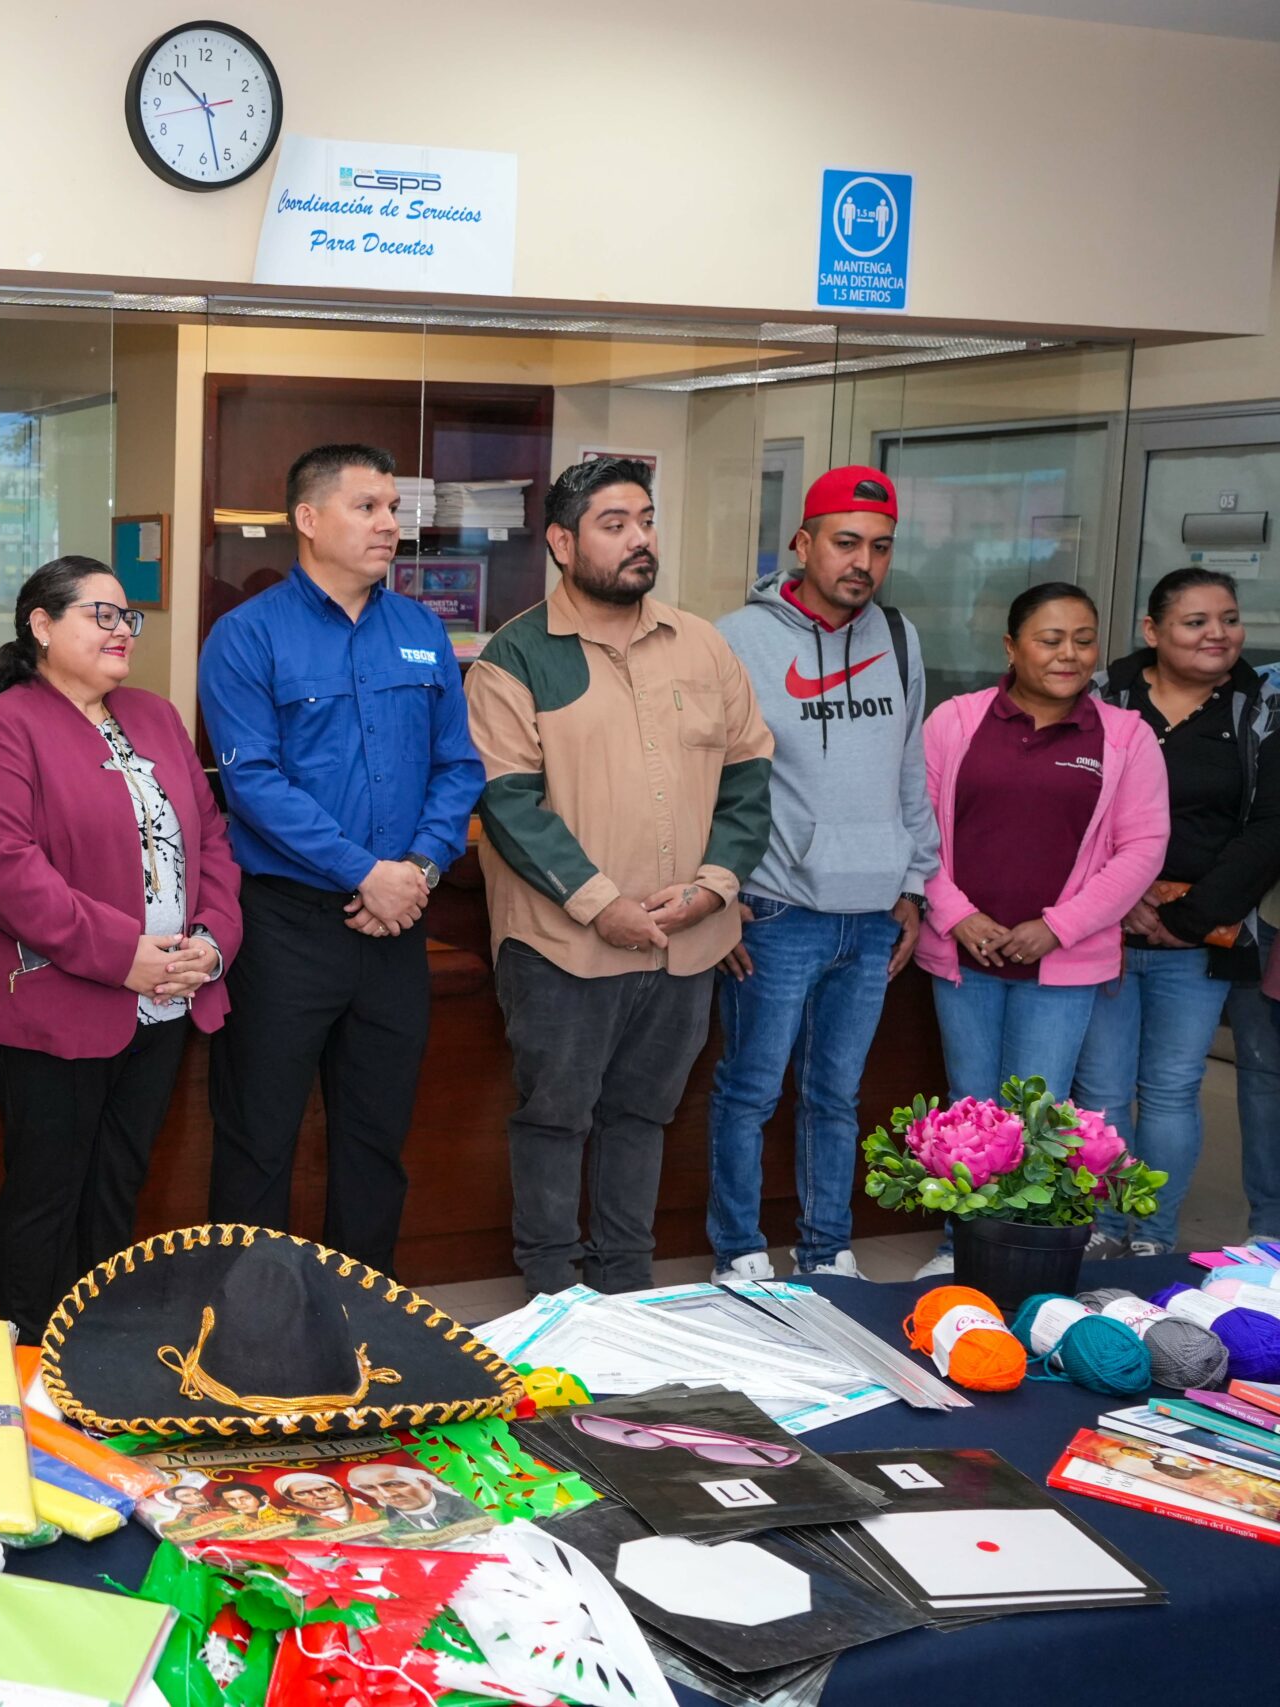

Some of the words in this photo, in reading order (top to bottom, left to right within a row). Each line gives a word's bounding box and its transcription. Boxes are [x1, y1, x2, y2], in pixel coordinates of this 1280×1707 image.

[175, 54, 187, 68] 11
[198, 48, 212, 62] 12
[226, 58, 231, 71] 1
[157, 72, 172, 86] 10
[241, 79, 249, 93] 2
[153, 97, 162, 111] 9
[246, 104, 255, 118] 3
[160, 122, 167, 135] 8
[239, 130, 248, 143] 4
[177, 144, 184, 157] 7
[223, 148, 232, 161] 5
[199, 152, 208, 165] 6
[354, 175, 441, 195] CSPD
[277, 188, 374, 215] Coordinación
[379, 200, 400, 217] de
[406, 200, 482, 223] Servicios
[856, 208, 867, 218] 1.5
[310, 229, 357, 252] Para
[362, 232, 434, 256] Docentes
[833, 260, 892, 274] MANTENGA
[820, 273, 848, 287] SANA
[850, 275, 904, 289] DISTANCIA
[833, 288, 847, 300] 1.5
[849, 289, 891, 302] METROS
[1220, 496, 1235, 508] 05
[399, 647, 437, 664] ITSON
[800, 701, 845, 720] JUST
[849, 698, 877, 719] DO
[878, 697, 894, 716] IT
[900, 1468, 925, 1483] 1
[1153, 1506, 1166, 1515] La
[1167, 1510, 1208, 1526] estrategia
[1209, 1520, 1224, 1531] del
[1225, 1524, 1258, 1539] Dragón
